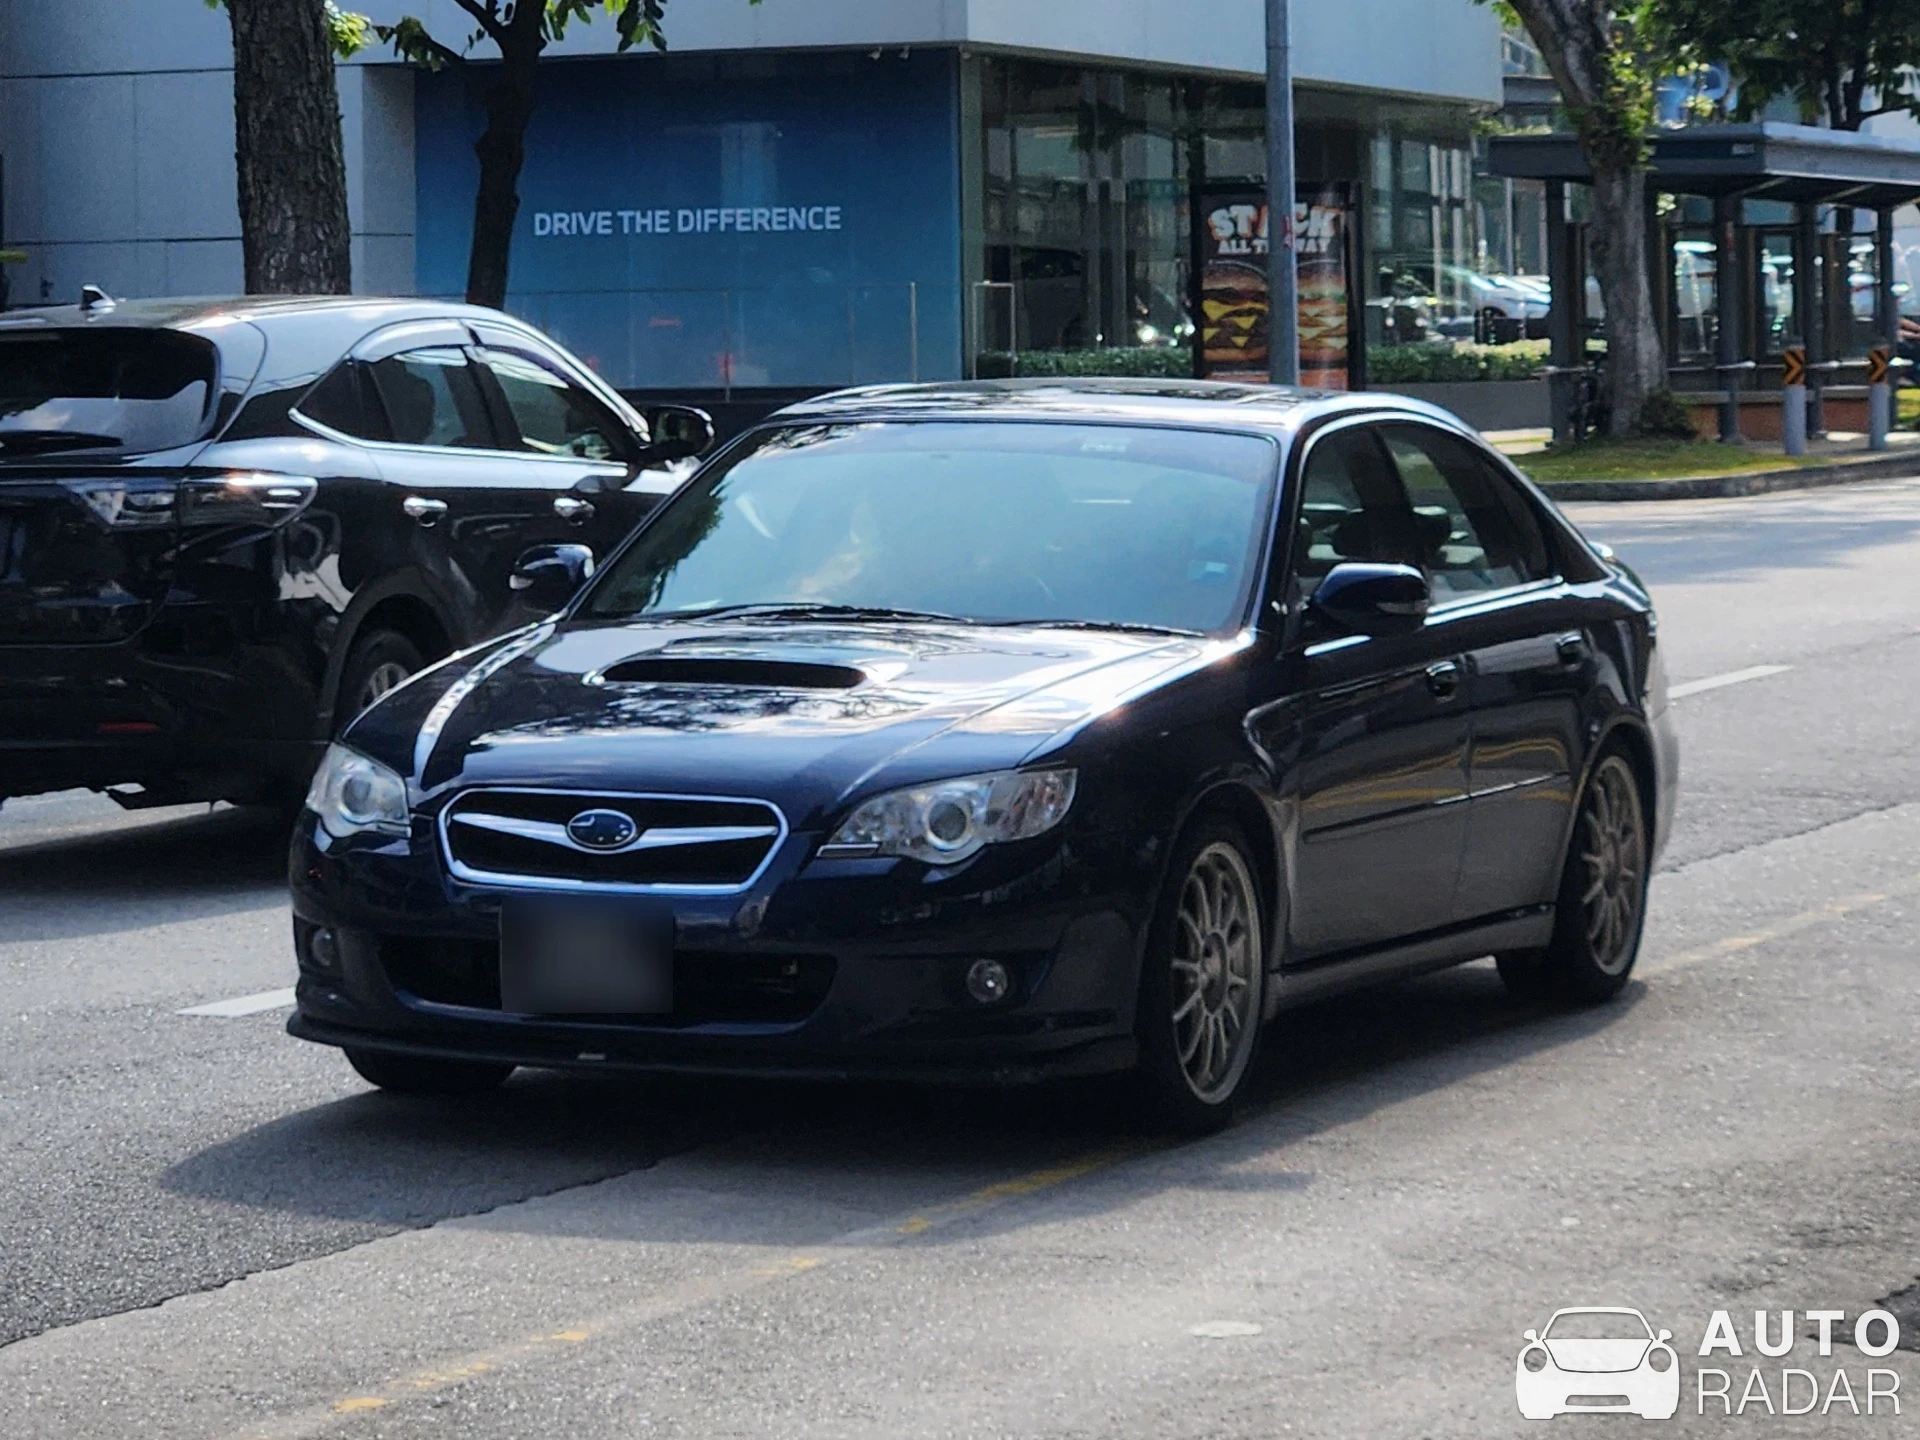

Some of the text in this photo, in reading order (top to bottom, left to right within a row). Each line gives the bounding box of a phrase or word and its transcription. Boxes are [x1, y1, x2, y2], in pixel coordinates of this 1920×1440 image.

[534, 206, 841, 236] DRIVE THE DIFFERENCE
[1217, 239, 1252, 254] ALL
